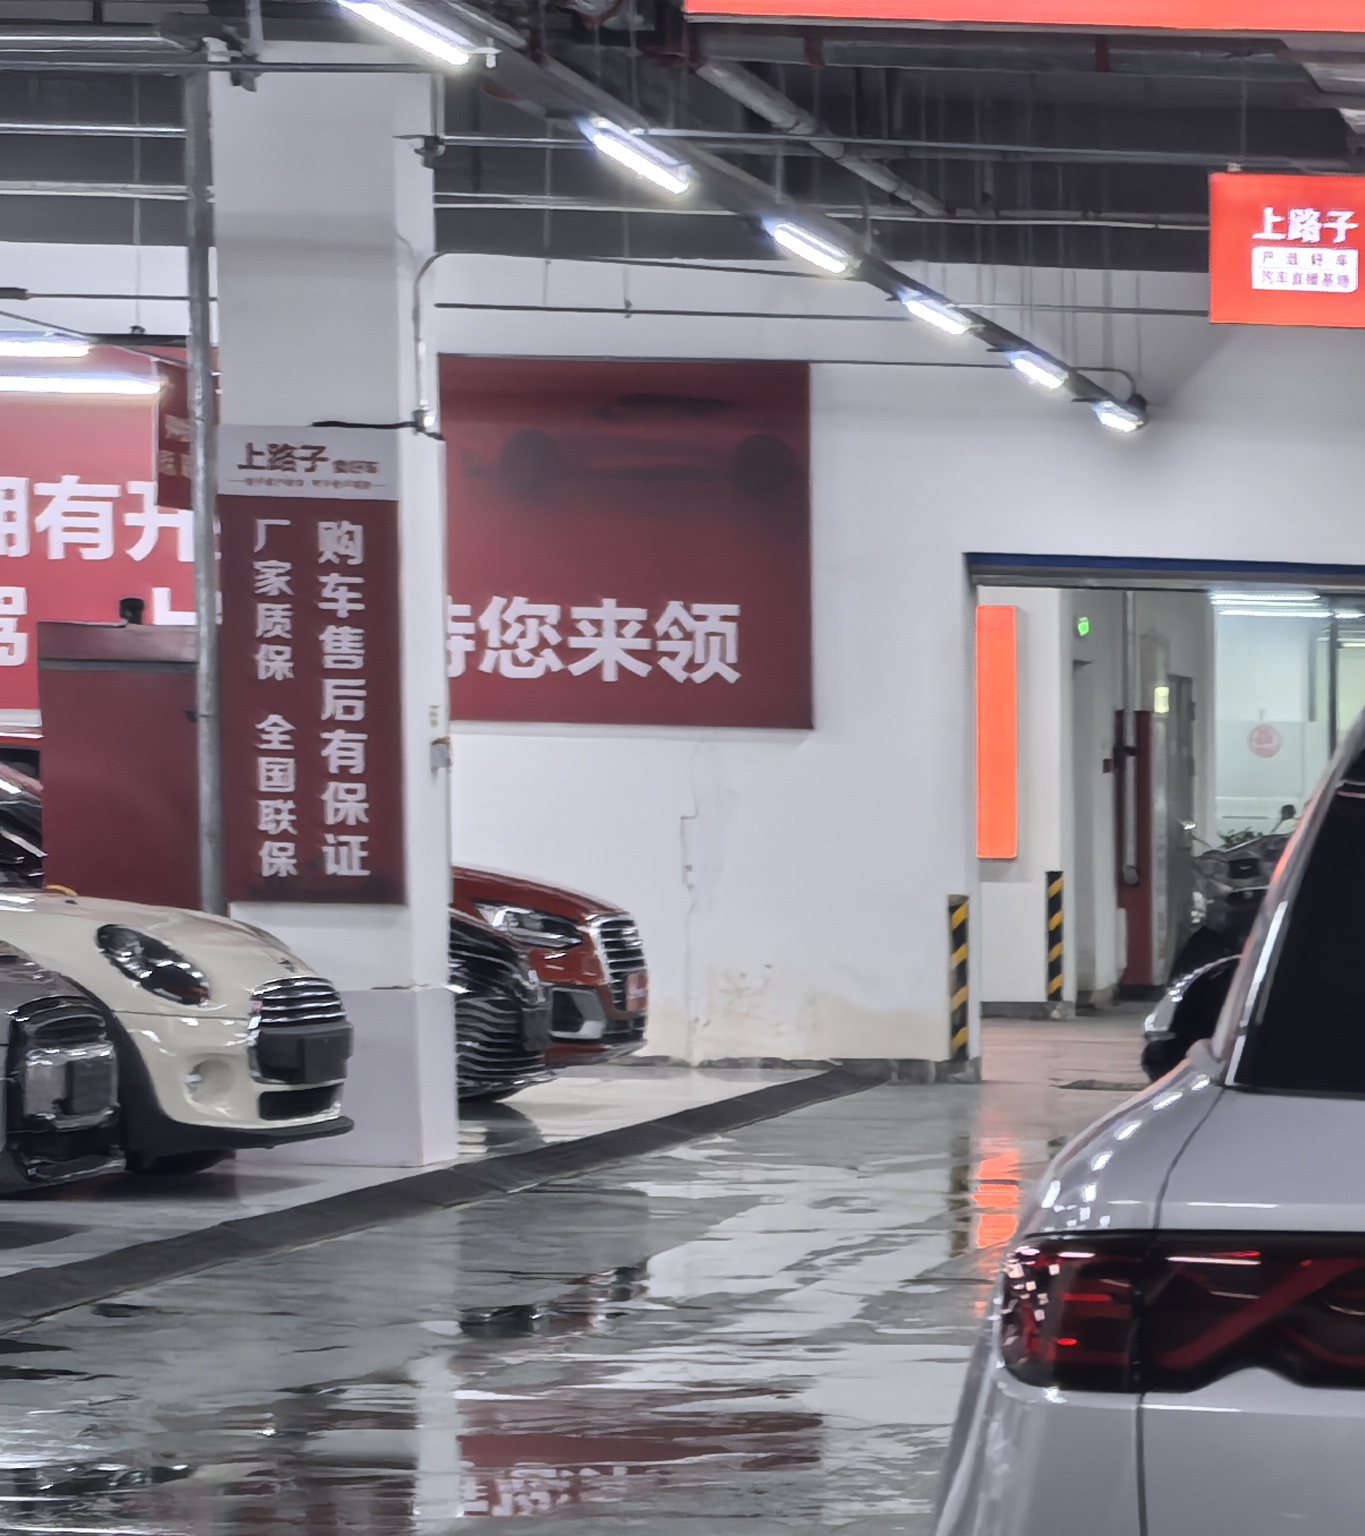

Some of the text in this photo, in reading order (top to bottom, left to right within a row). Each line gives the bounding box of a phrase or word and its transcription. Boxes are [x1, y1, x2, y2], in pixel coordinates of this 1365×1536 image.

[1251, 206, 1359, 243] 上路子
[237, 442, 330, 473] 上路子
[253, 518, 295, 681] 厂家质保
[316, 520, 371, 877] 购车售后有保证
[254, 714, 299, 878] 全国联保
